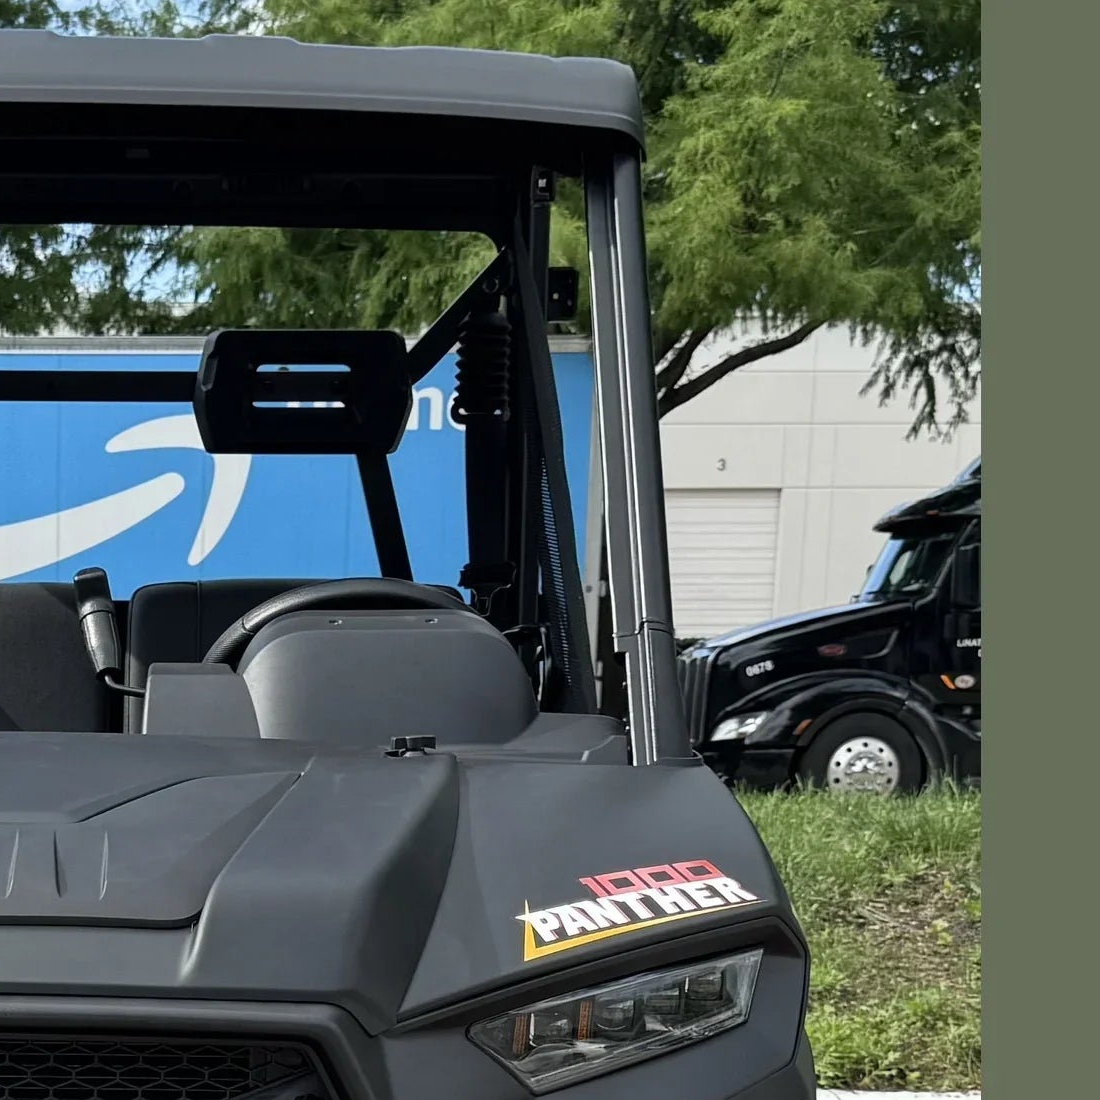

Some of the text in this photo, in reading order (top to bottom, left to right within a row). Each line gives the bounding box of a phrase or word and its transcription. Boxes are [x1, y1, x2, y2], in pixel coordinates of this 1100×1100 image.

[716, 458, 727, 472] 3
[578, 859, 726, 898] 1000
[514, 876, 758, 943] PANTHER
